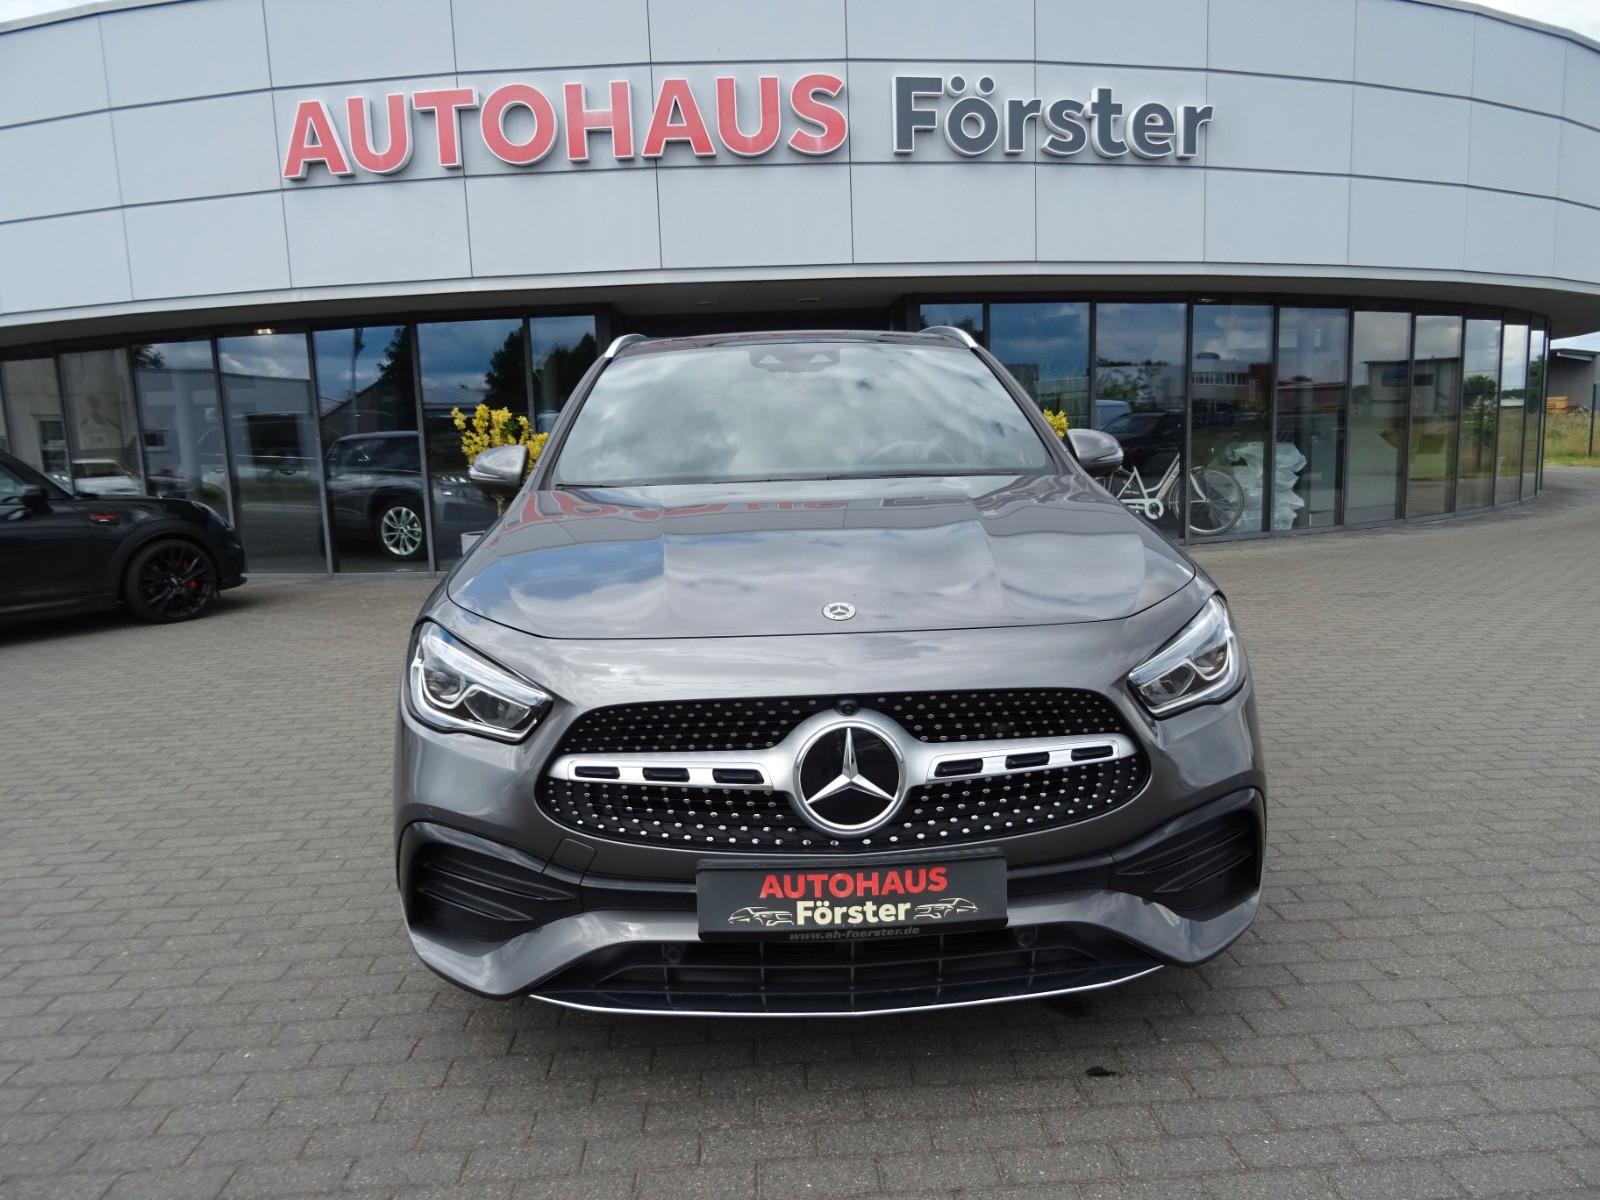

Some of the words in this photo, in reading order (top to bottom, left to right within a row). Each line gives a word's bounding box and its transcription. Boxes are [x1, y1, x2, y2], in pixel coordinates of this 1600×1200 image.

[283, 73, 849, 180] AUTOHAUS
[892, 74, 1214, 160] Förster
[759, 866, 948, 899] AUTOHAUS
[796, 900, 911, 926] Förster
[789, 926, 920, 941] www.ah-foerster.de
